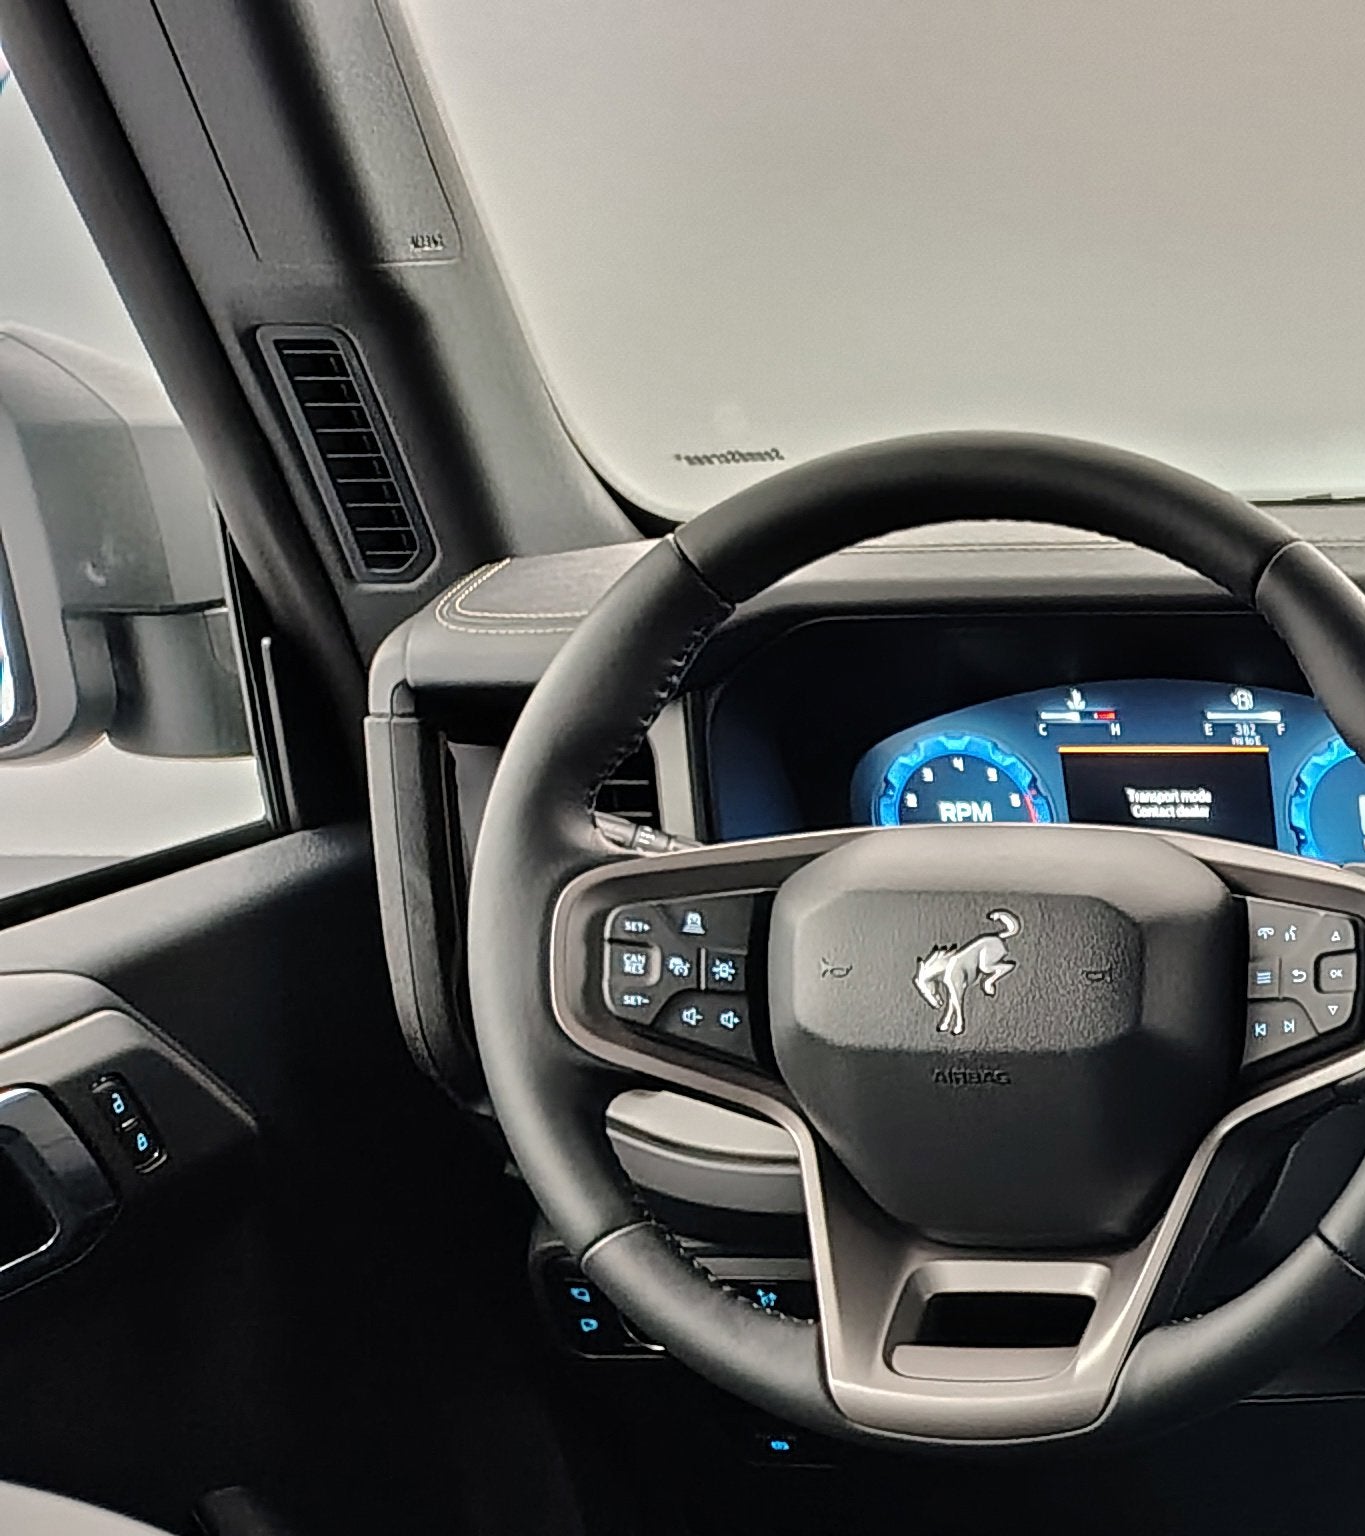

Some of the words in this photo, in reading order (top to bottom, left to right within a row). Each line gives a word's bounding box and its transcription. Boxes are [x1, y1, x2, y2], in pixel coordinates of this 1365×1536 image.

[1038, 723, 1048, 737] C
[1110, 722, 1121, 737] H
[1204, 723, 1214, 737] E
[1277, 723, 1286, 736] F
[1124, 787, 1180, 805] Transport
[1180, 786, 1213, 804] mode
[939, 800, 993, 822] RPM
